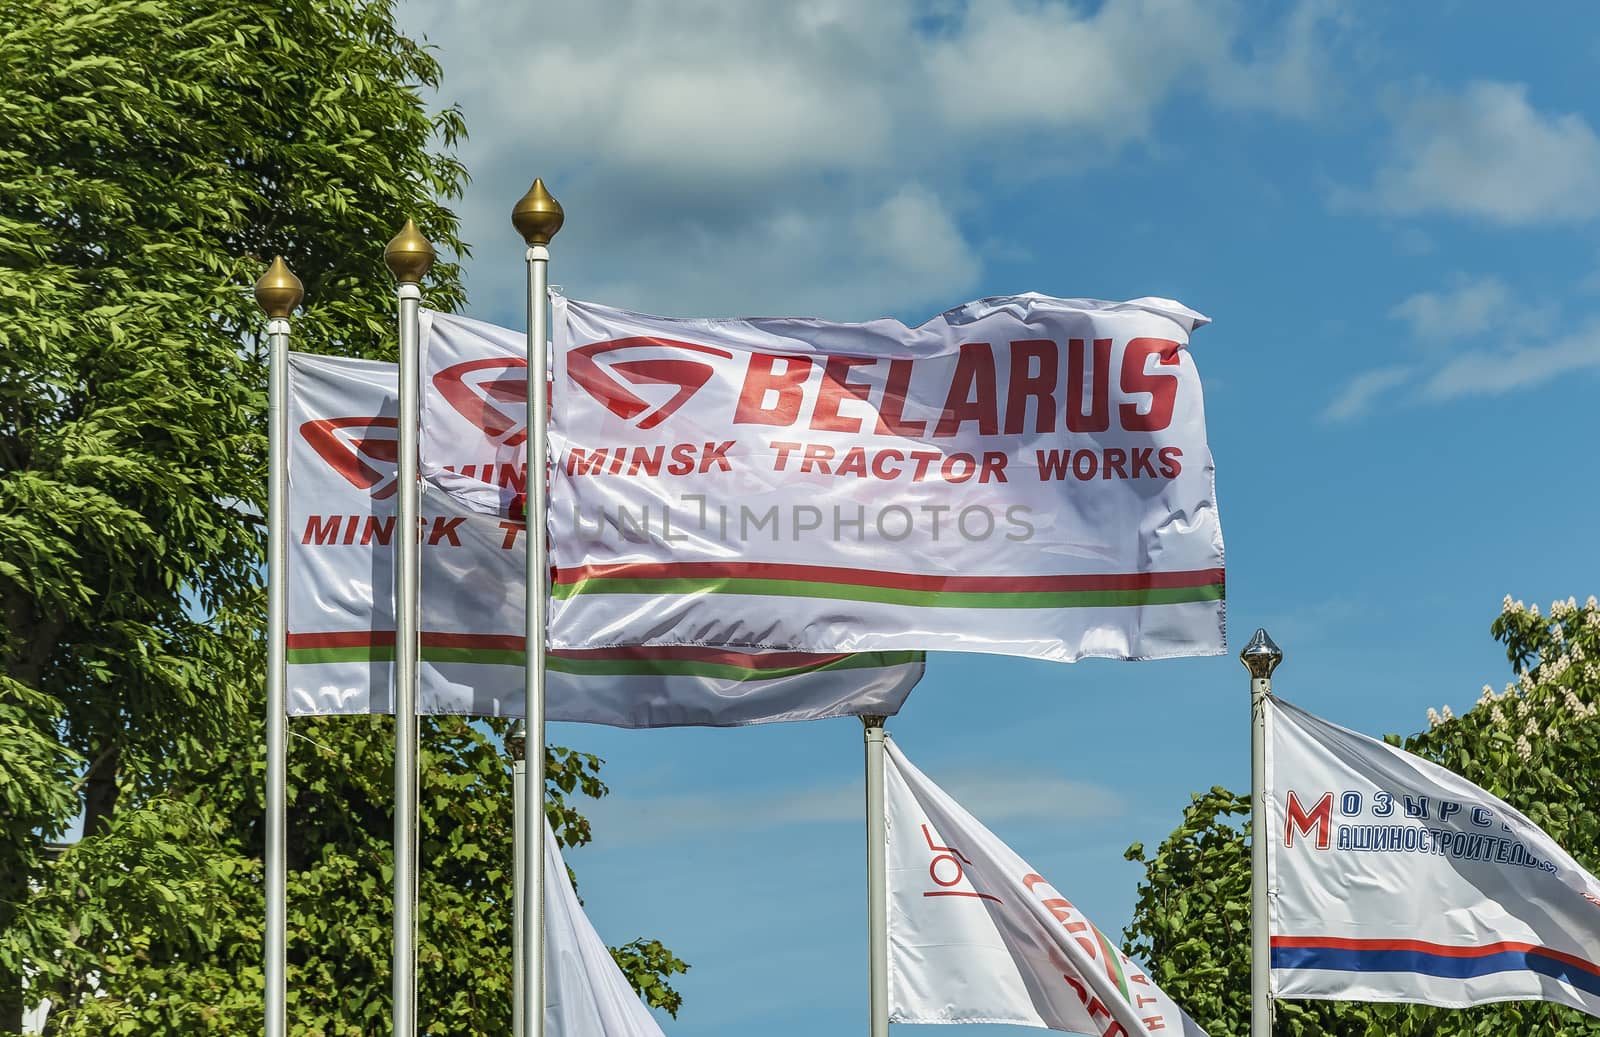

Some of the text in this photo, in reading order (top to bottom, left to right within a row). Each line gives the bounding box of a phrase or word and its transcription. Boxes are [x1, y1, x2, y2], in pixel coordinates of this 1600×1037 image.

[732, 337, 1181, 439] BELARUS
[566, 440, 1184, 484] MINSK TRACTOR WORKS
